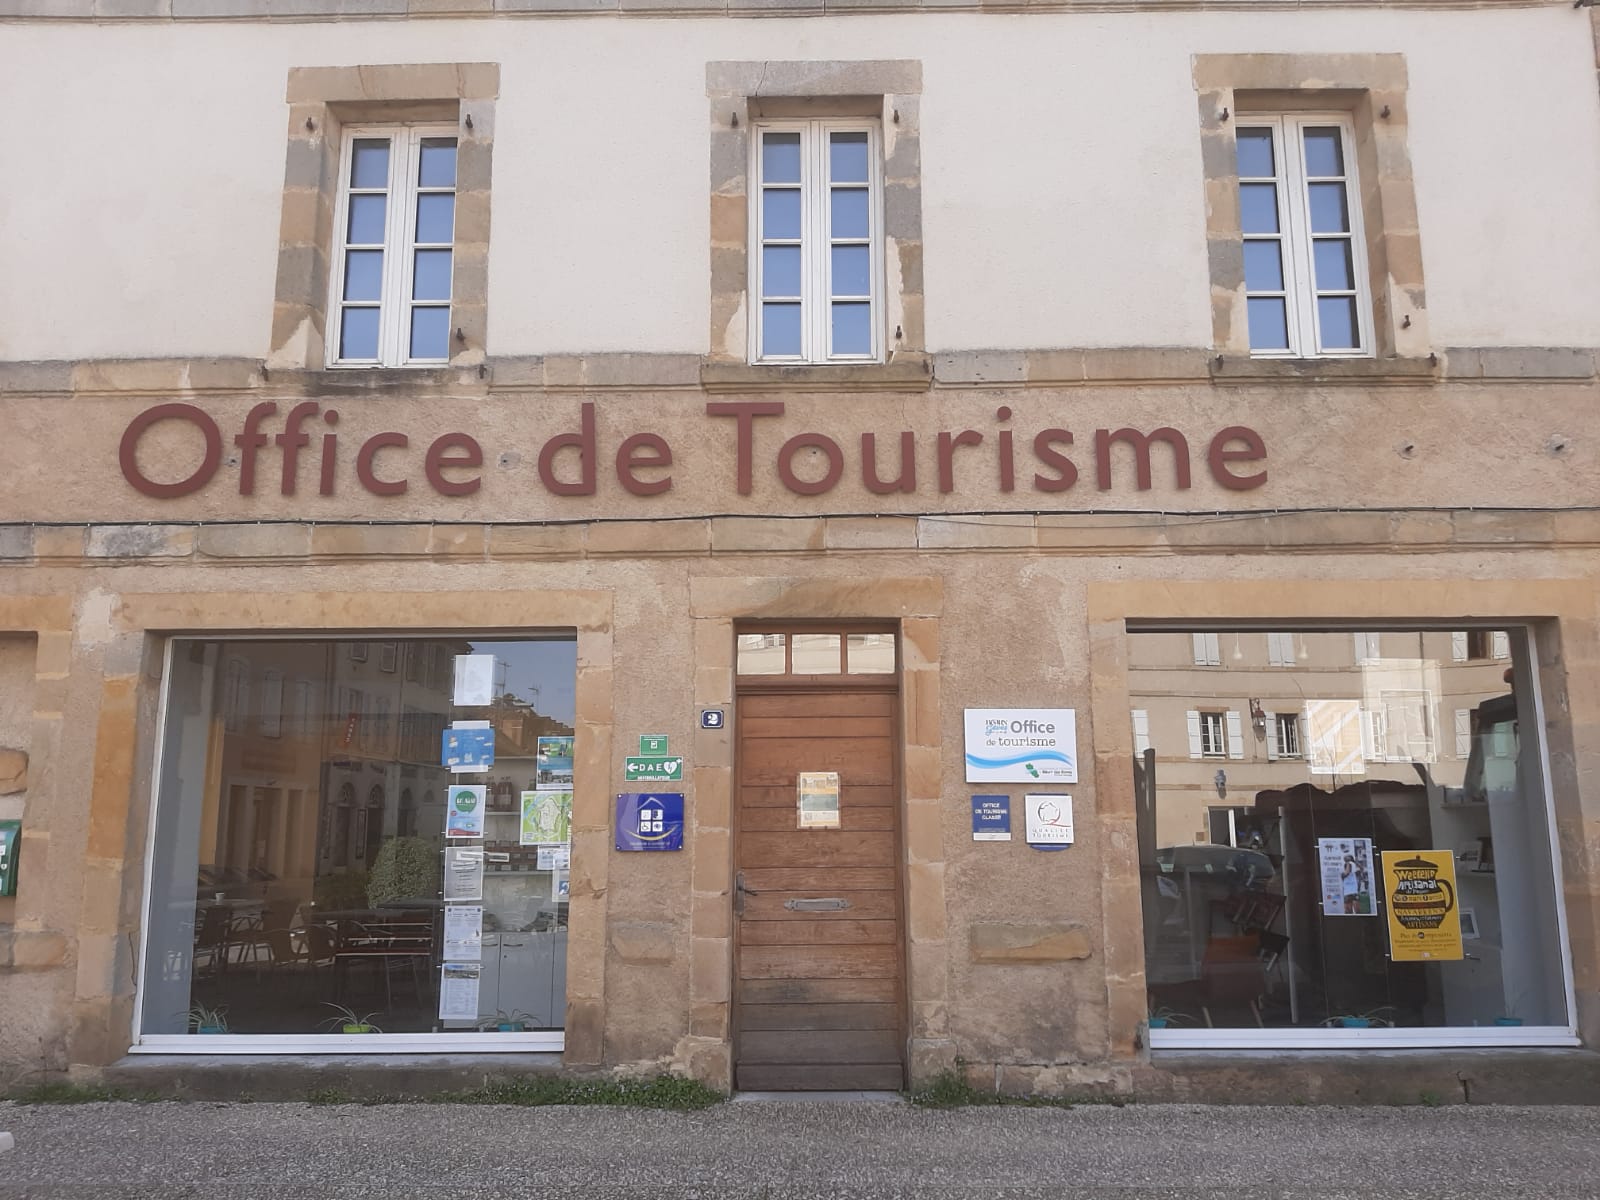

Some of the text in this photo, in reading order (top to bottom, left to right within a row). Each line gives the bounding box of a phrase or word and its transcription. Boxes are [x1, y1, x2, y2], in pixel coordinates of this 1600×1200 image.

[119, 402, 1268, 499] Office de Tourisme
[708, 713, 719, 725] 2
[1010, 720, 1056, 734] Office
[986, 736, 1057, 747] de tourisme
[639, 763, 663, 772] DAE
